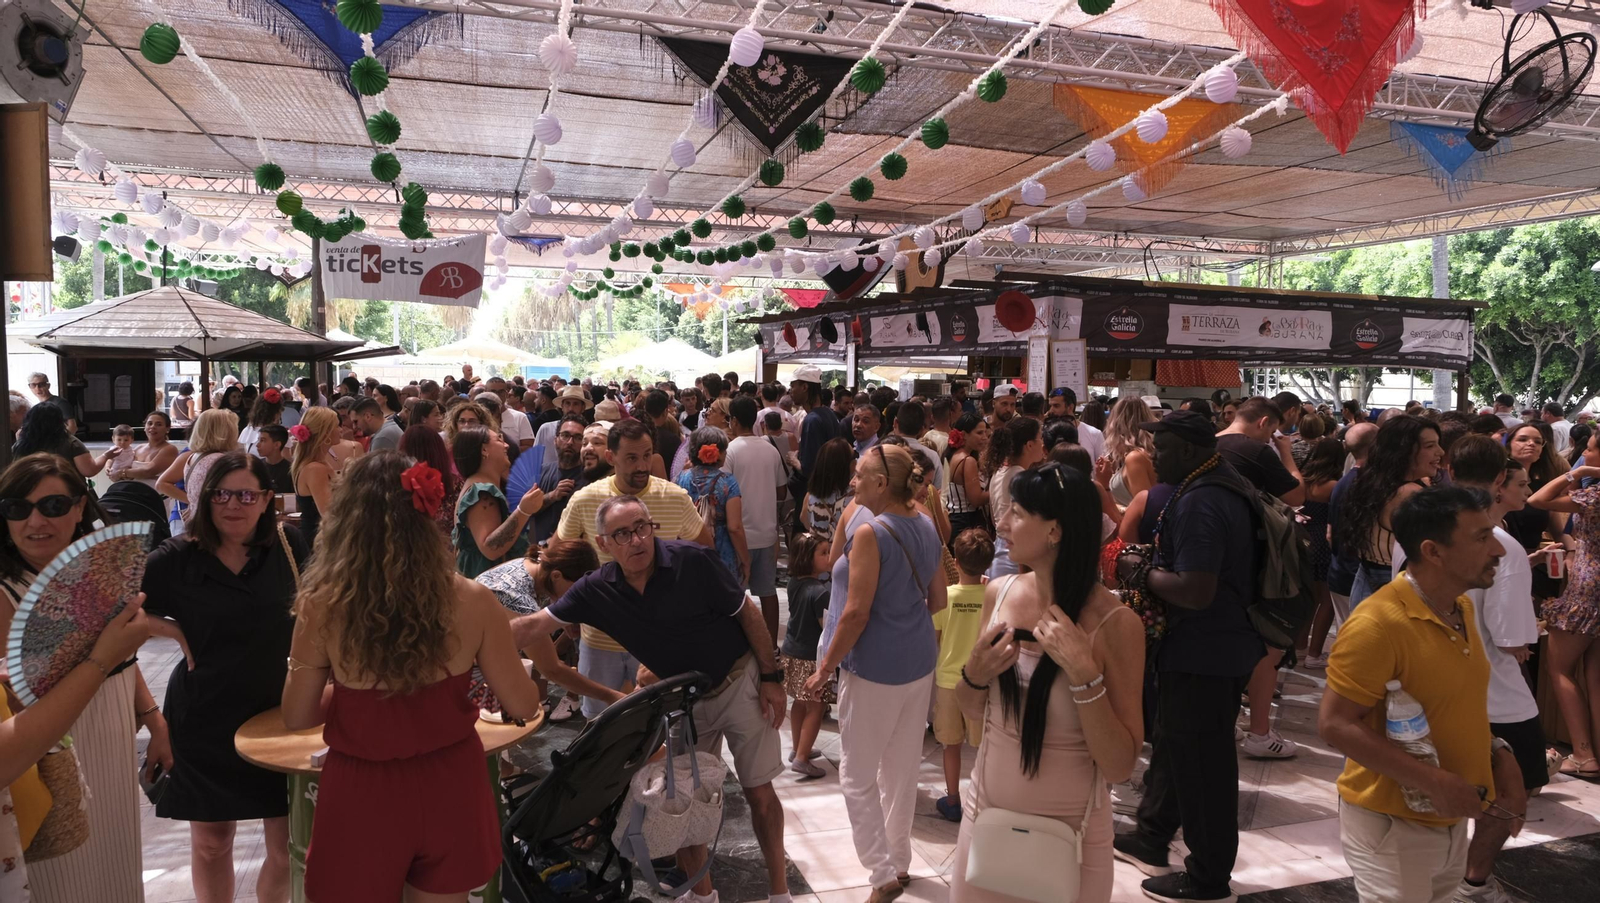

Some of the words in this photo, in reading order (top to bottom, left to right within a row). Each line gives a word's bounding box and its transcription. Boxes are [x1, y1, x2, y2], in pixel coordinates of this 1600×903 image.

[326, 246, 348, 254] venta
[350, 245, 360, 254] de
[1110, 315, 1138, 324] Estrella
[1192, 315, 1240, 329] TERRAZA
[1110, 323, 1136, 332] Galicia
[1356, 327, 1379, 336] Estrella
[1273, 329, 1324, 341] BURANA
[1356, 334, 1379, 343] Galicia
